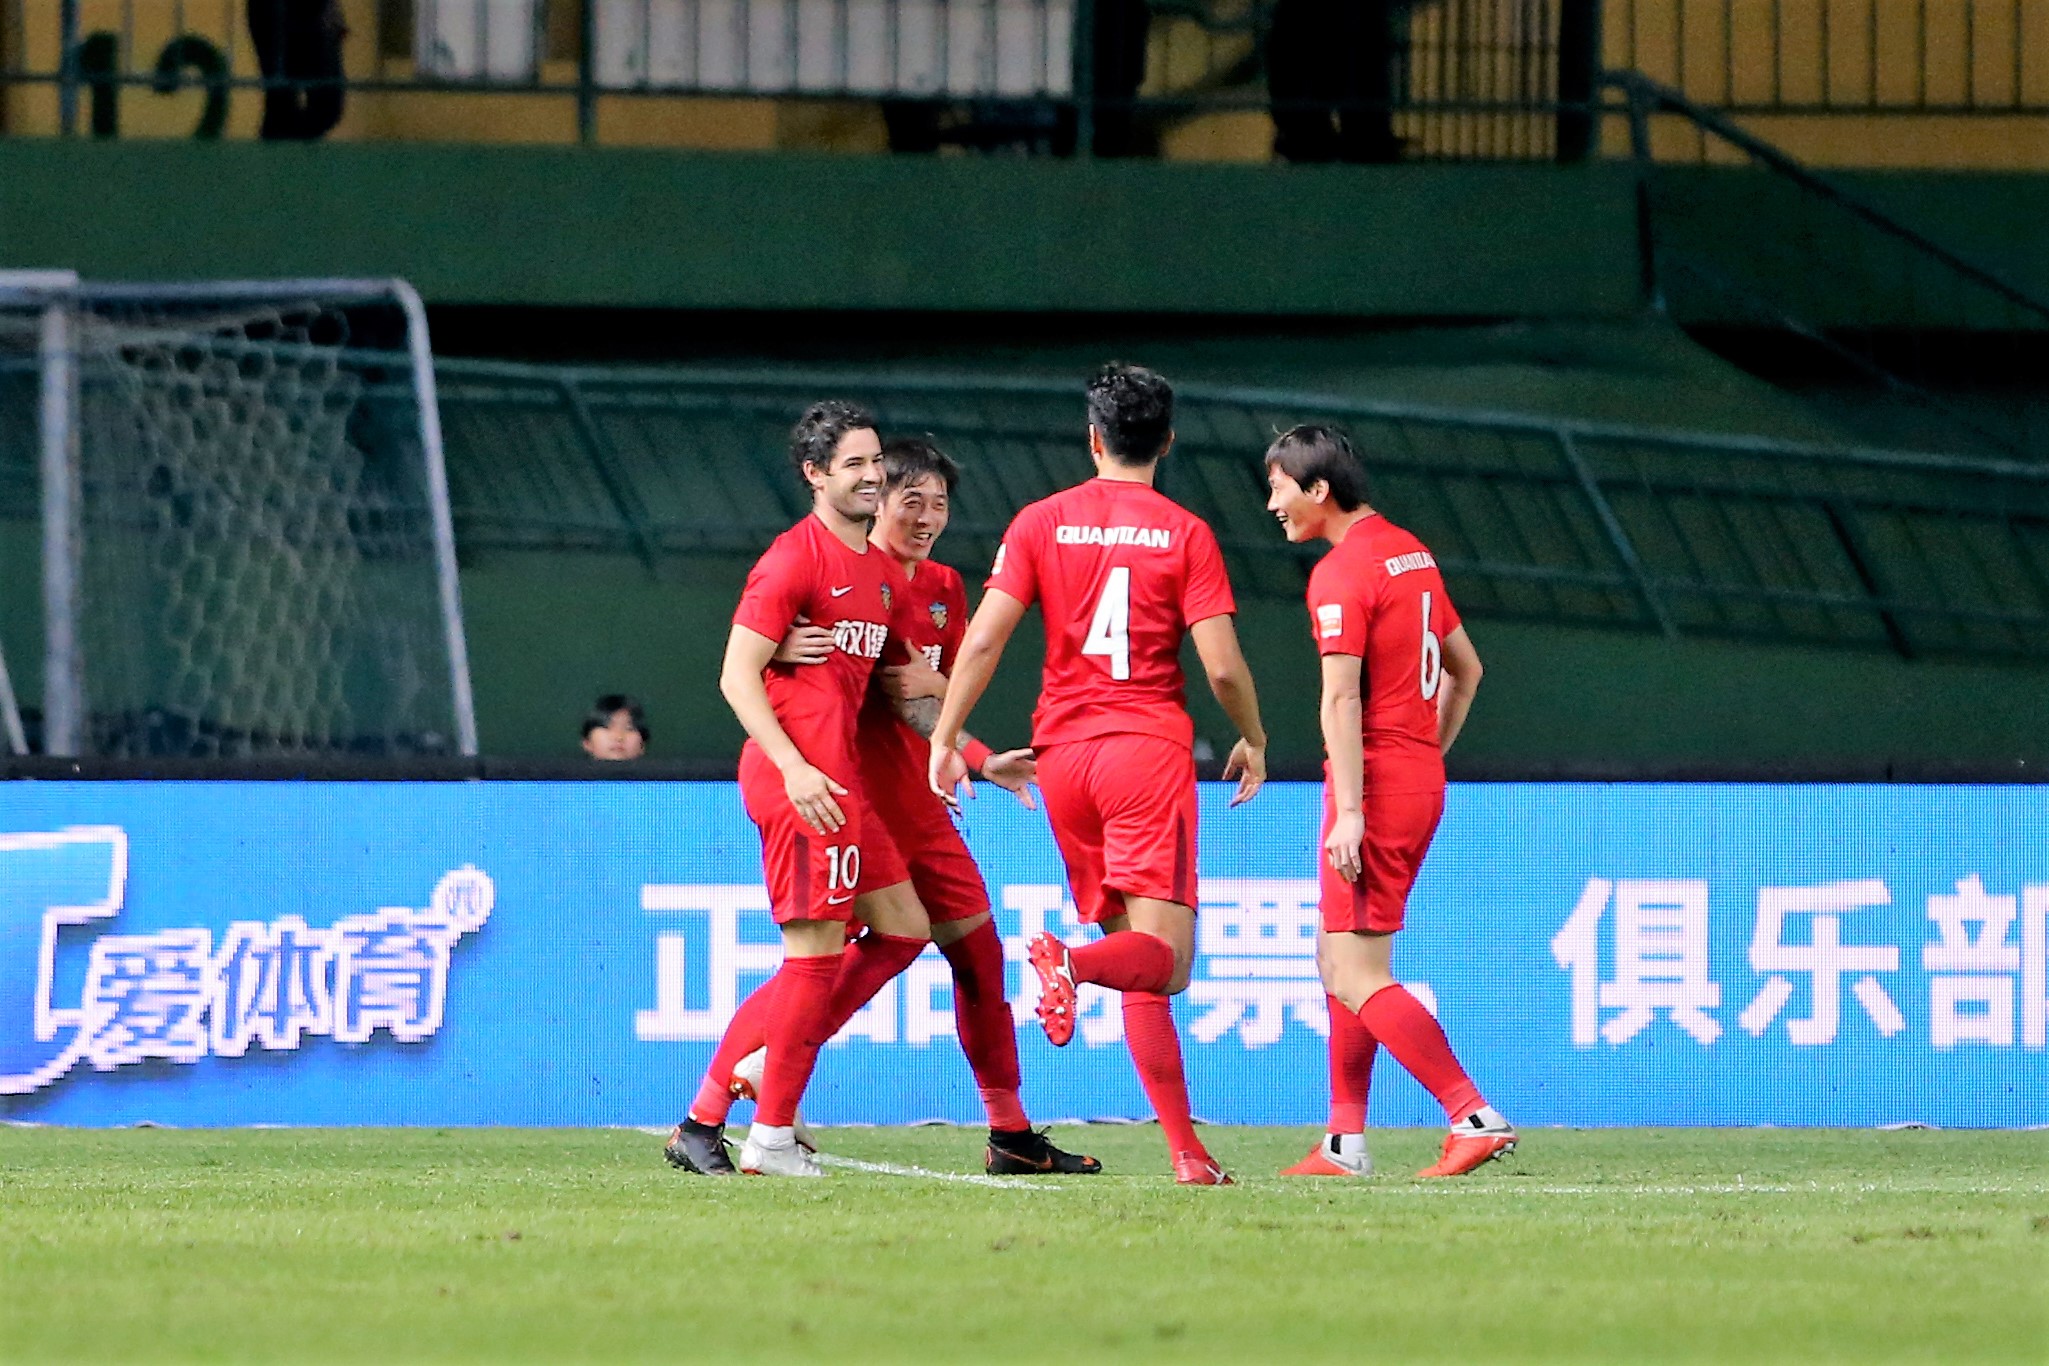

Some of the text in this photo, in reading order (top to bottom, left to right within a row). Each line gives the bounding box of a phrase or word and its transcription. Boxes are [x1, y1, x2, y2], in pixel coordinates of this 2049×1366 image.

[1082, 567, 1130, 680] 4
[1421, 592, 1441, 700] 6
[825, 844, 860, 890] 10
